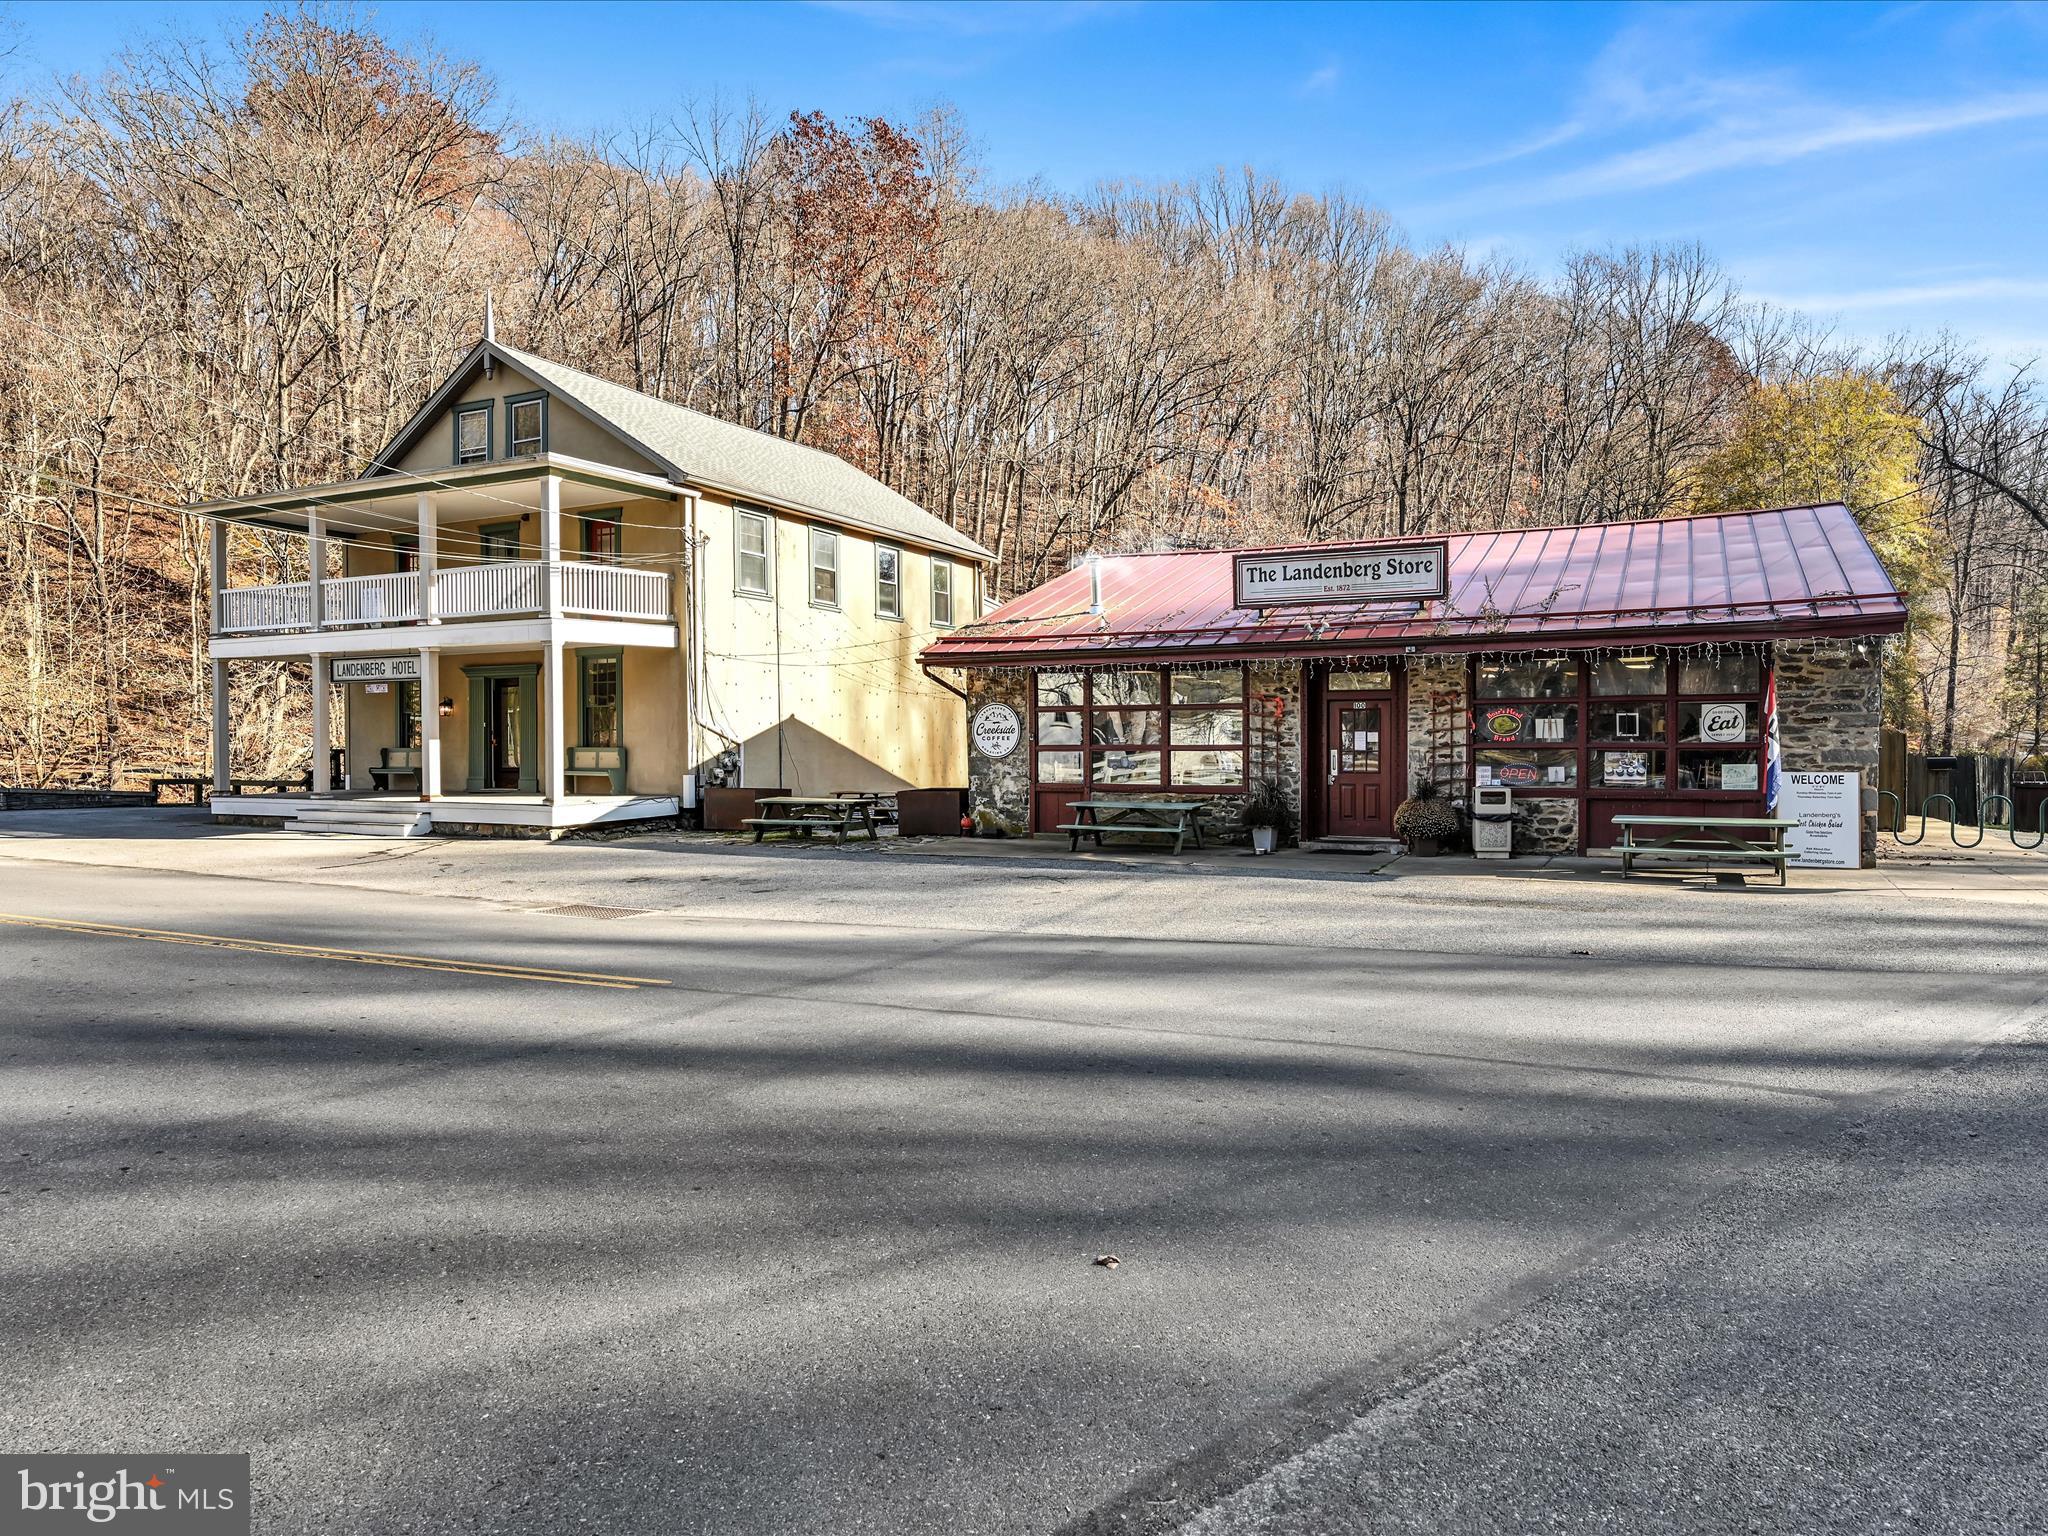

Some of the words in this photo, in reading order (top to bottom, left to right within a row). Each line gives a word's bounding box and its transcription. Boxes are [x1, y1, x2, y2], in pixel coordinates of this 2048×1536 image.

[1246, 567, 1277, 583] The
[1282, 561, 1382, 582] Landenberg
[1386, 558, 1433, 575] Store
[1336, 584, 1350, 592] 1872
[337, 662, 386, 677] LANDENBERG
[392, 661, 417, 675] HOTEL
[1486, 708, 1505, 719] Boar's
[1506, 708, 1524, 719] Head
[1707, 714, 1740, 732] Eat
[976, 723, 1016, 736] Creekside
[1500, 767, 1537, 780] OPEN
[1791, 774, 1845, 785] WELCOME
[1808, 819, 1827, 828] Chicken
[1828, 819, 1843, 828] Salad
[1790, 857, 1845, 865] www.landenbergstore.com
